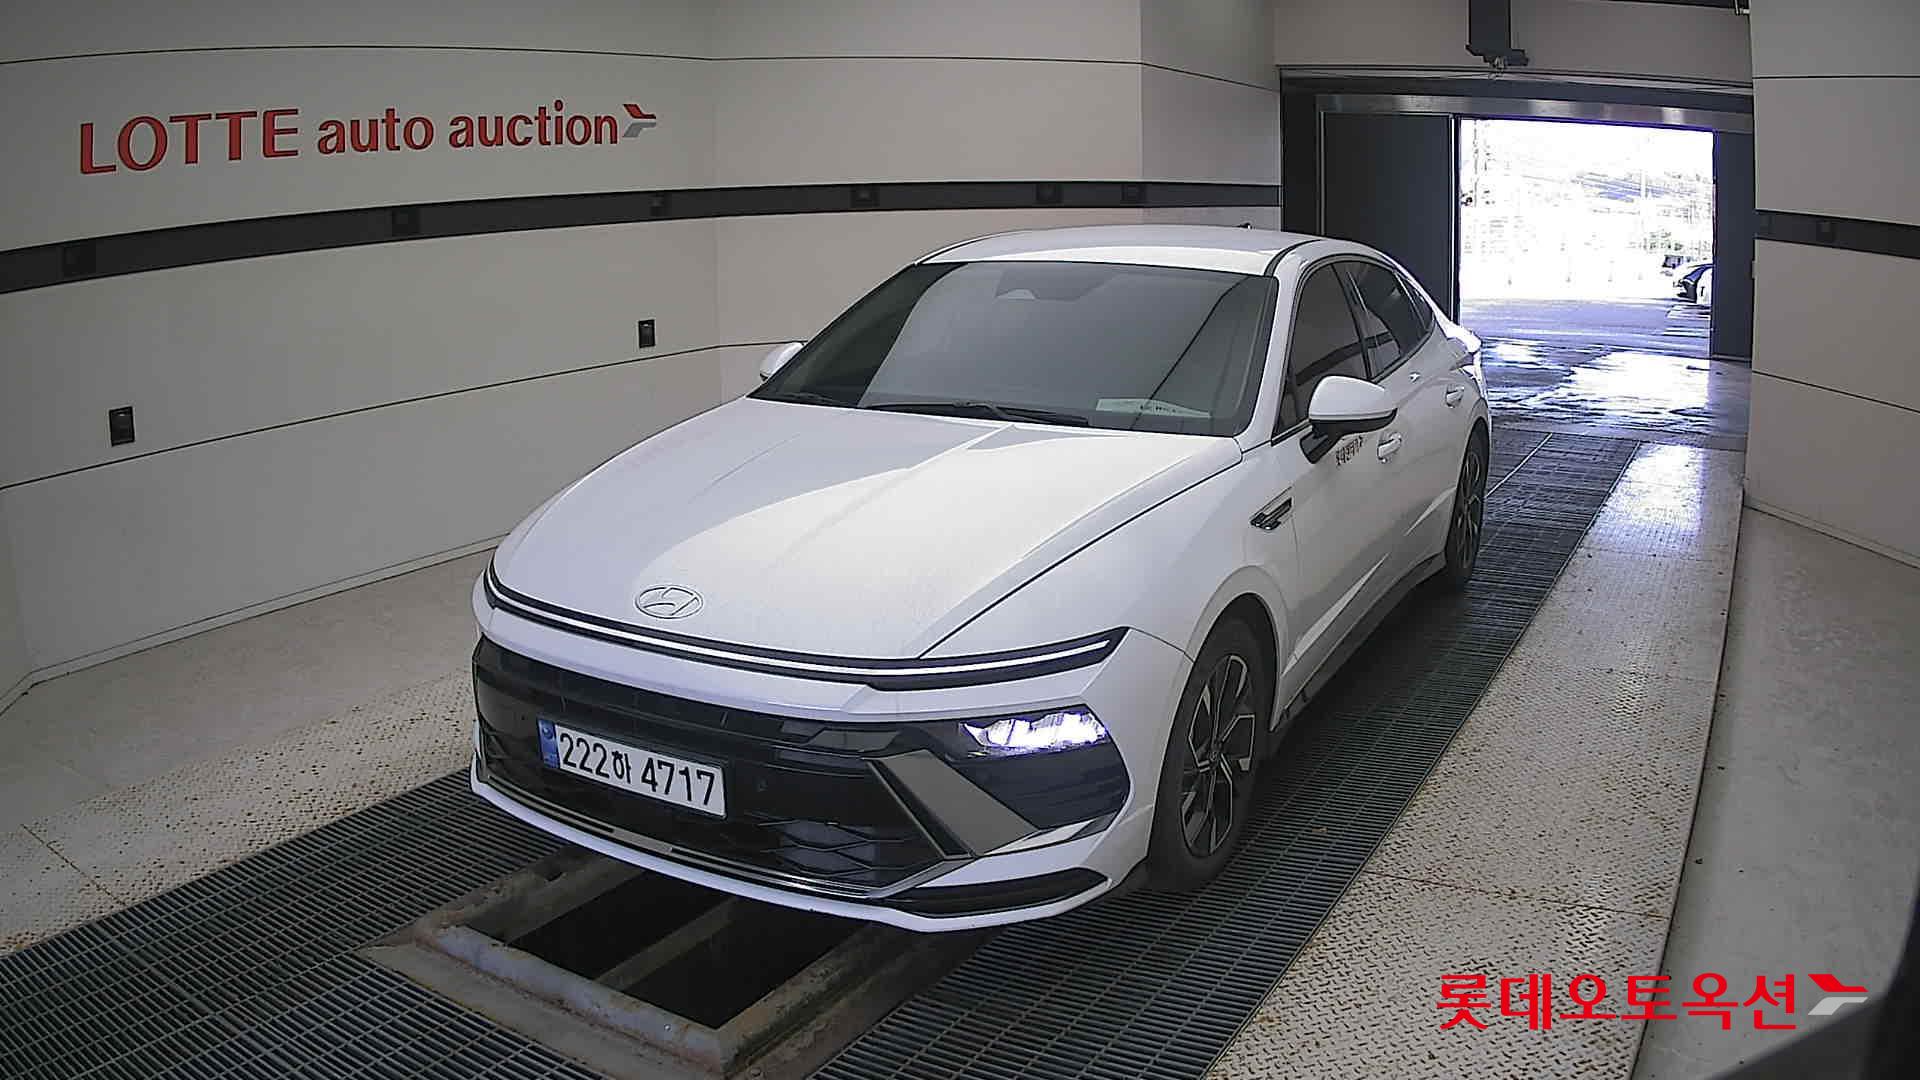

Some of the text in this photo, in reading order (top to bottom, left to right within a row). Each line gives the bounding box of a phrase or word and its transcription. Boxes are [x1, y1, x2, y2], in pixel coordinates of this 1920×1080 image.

[80, 99, 619, 175] LOTTE auto auction
[559, 733, 715, 806] 222하 4717
